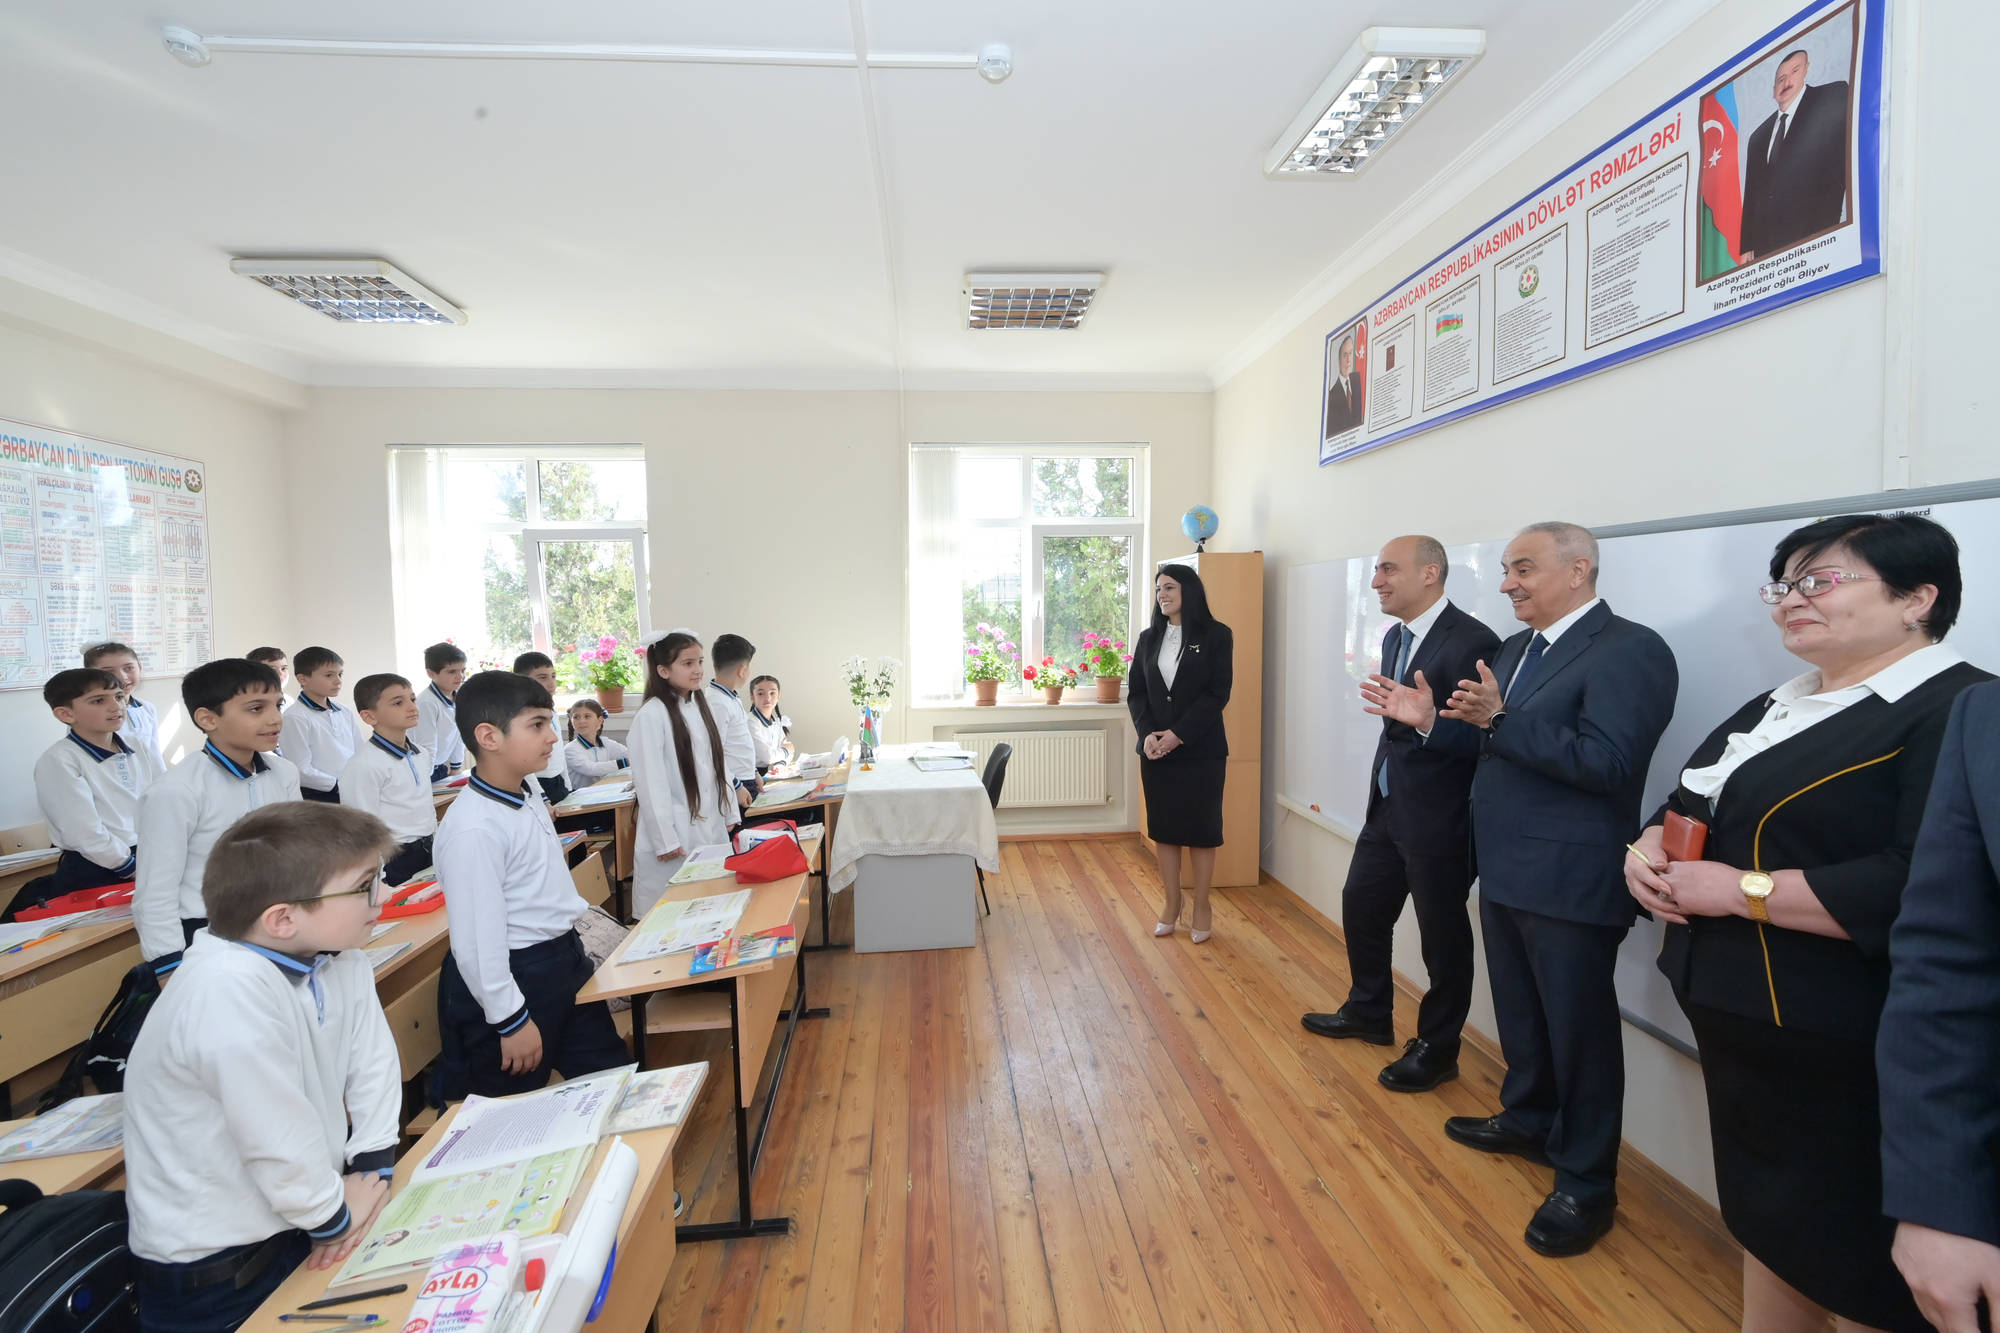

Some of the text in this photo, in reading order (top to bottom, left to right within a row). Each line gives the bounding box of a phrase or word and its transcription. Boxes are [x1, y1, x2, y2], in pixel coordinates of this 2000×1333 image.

[1373, 281, 1427, 328] AZƏRBAYCAN
[1428, 220, 1524, 296] RESPUBLİKASININ
[1528, 178, 1586, 234] DÖVLƏT
[1590, 112, 1682, 193] RƏMZLƏRİ
[1706, 235, 1837, 293] Azərbaycan Respublikasının
[1730, 260, 1807, 294] Prezidenti cənab
[1713, 263, 1831, 311] İlham Heydər oğlu Əliyev
[158, 466, 182, 493] GUŞƏ
[422, 1271, 479, 1295] AYLA
